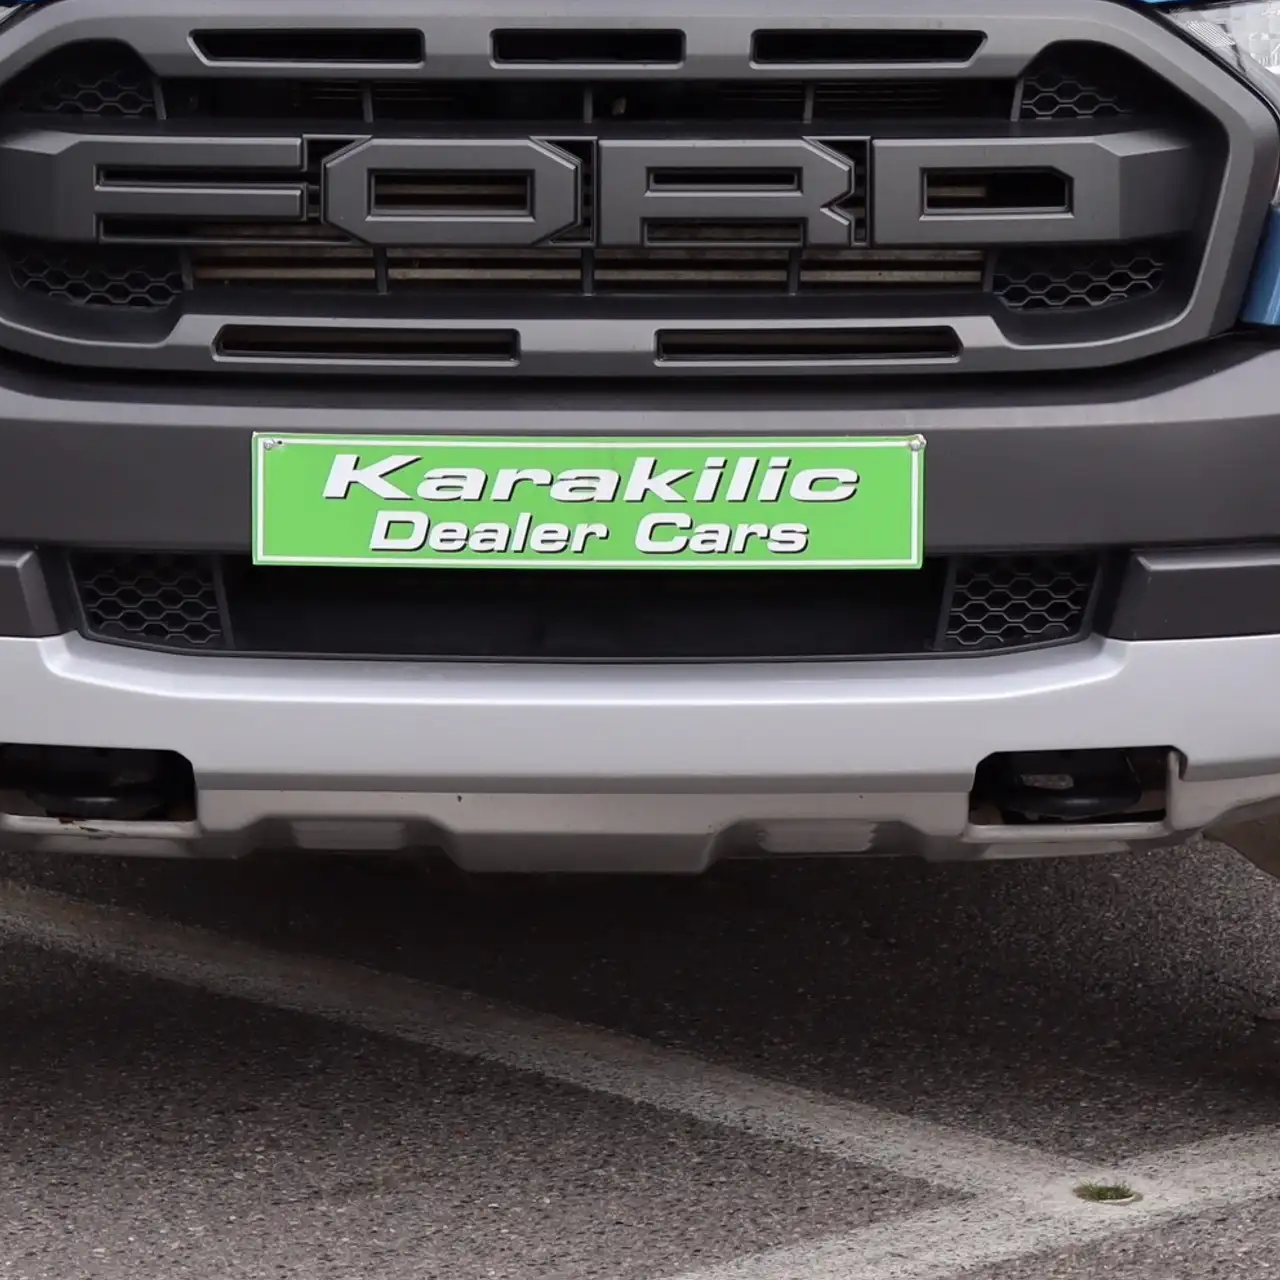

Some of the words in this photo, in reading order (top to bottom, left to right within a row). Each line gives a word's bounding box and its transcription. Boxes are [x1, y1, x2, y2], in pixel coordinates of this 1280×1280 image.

[322, 453, 861, 503] Karakilic
[368, 509, 610, 553] Dealer
[634, 512, 810, 554] Cars
